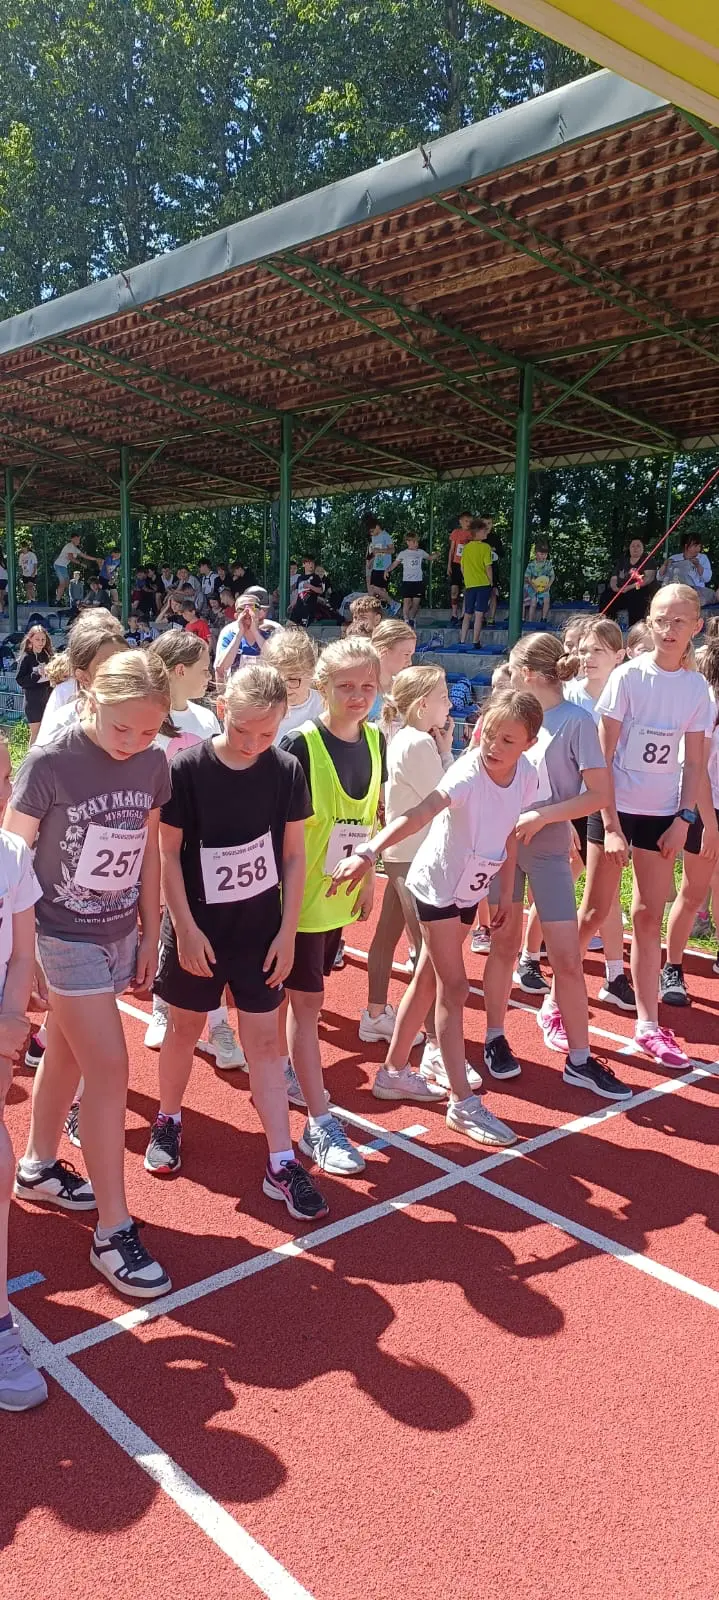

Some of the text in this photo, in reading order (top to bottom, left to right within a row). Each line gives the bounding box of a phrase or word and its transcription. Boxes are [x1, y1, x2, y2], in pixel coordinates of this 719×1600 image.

[642, 742, 671, 765] 82
[66, 790, 154, 823] STAY MAGIC
[90, 847, 141, 878] 257
[215, 855, 268, 892] 258
